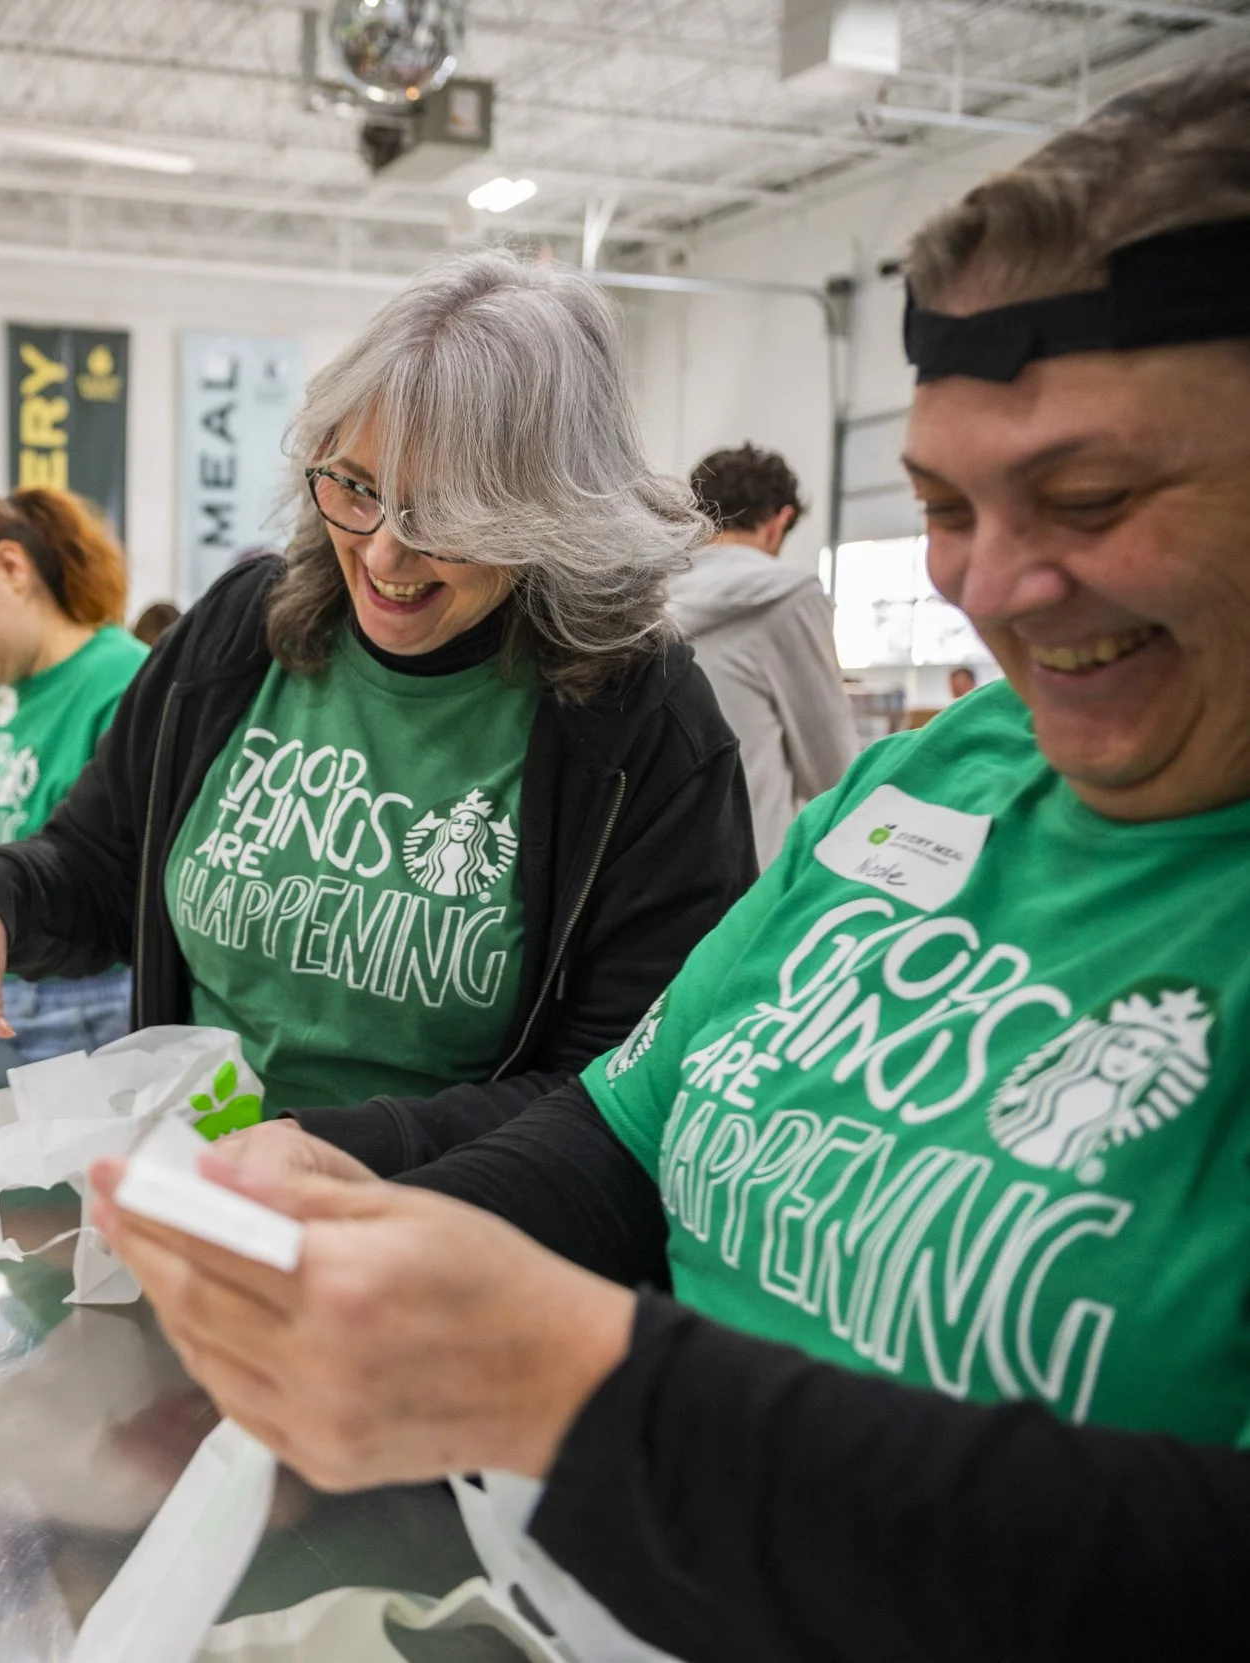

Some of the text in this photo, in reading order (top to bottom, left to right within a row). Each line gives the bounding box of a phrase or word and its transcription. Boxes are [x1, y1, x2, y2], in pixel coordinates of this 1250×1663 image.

[19, 343, 69, 491] ERY
[201, 356, 239, 547] MEAL
[228, 728, 367, 803] GOOD
[195, 831, 274, 879] ARE
[217, 786, 414, 879] THINGS
[176, 857, 508, 1008] HAPPENING
[778, 897, 1031, 1005] GOOD
[681, 1030, 784, 1110] ARE
[734, 976, 1071, 1124] THINGS
